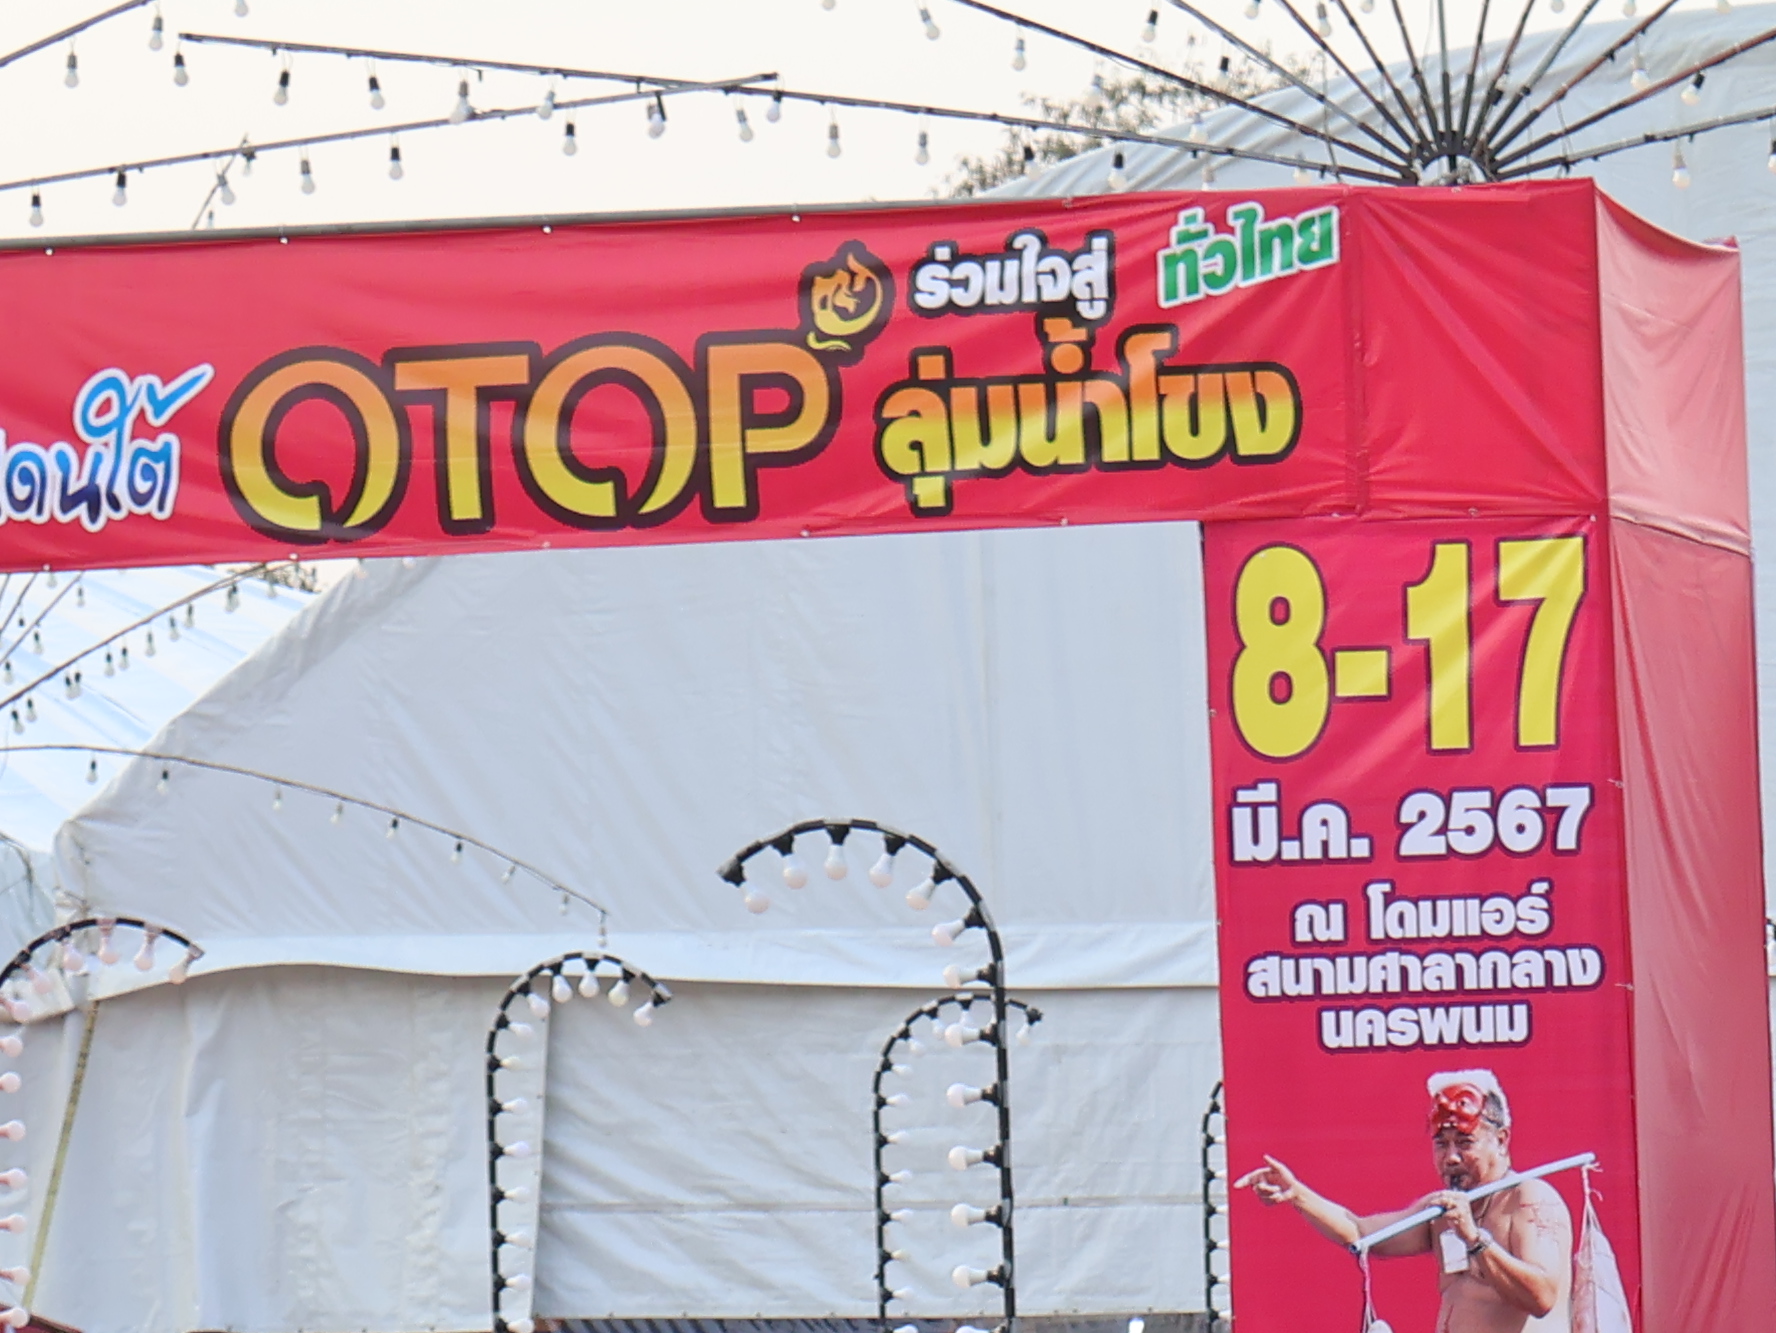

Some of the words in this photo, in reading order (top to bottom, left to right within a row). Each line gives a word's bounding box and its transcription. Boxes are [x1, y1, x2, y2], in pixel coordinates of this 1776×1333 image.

[1158, 204, 1340, 308] ทั่วไทย
[0, 368, 211, 529] ดนใต้
[225, 336, 836, 538] OTOP
[880, 319, 1297, 512] ลุ่มน้ำโขง
[1232, 535, 1587, 758] 8-17
[1231, 781, 1371, 862] มี.ค.
[1399, 787, 1591, 856] 2567
[1293, 900, 1346, 942] ณ
[1365, 880, 1552, 942] โดมแอร์
[1246, 947, 1604, 999] สนามศาลากลาง
[1320, 1003, 1531, 1049] นครพนม
